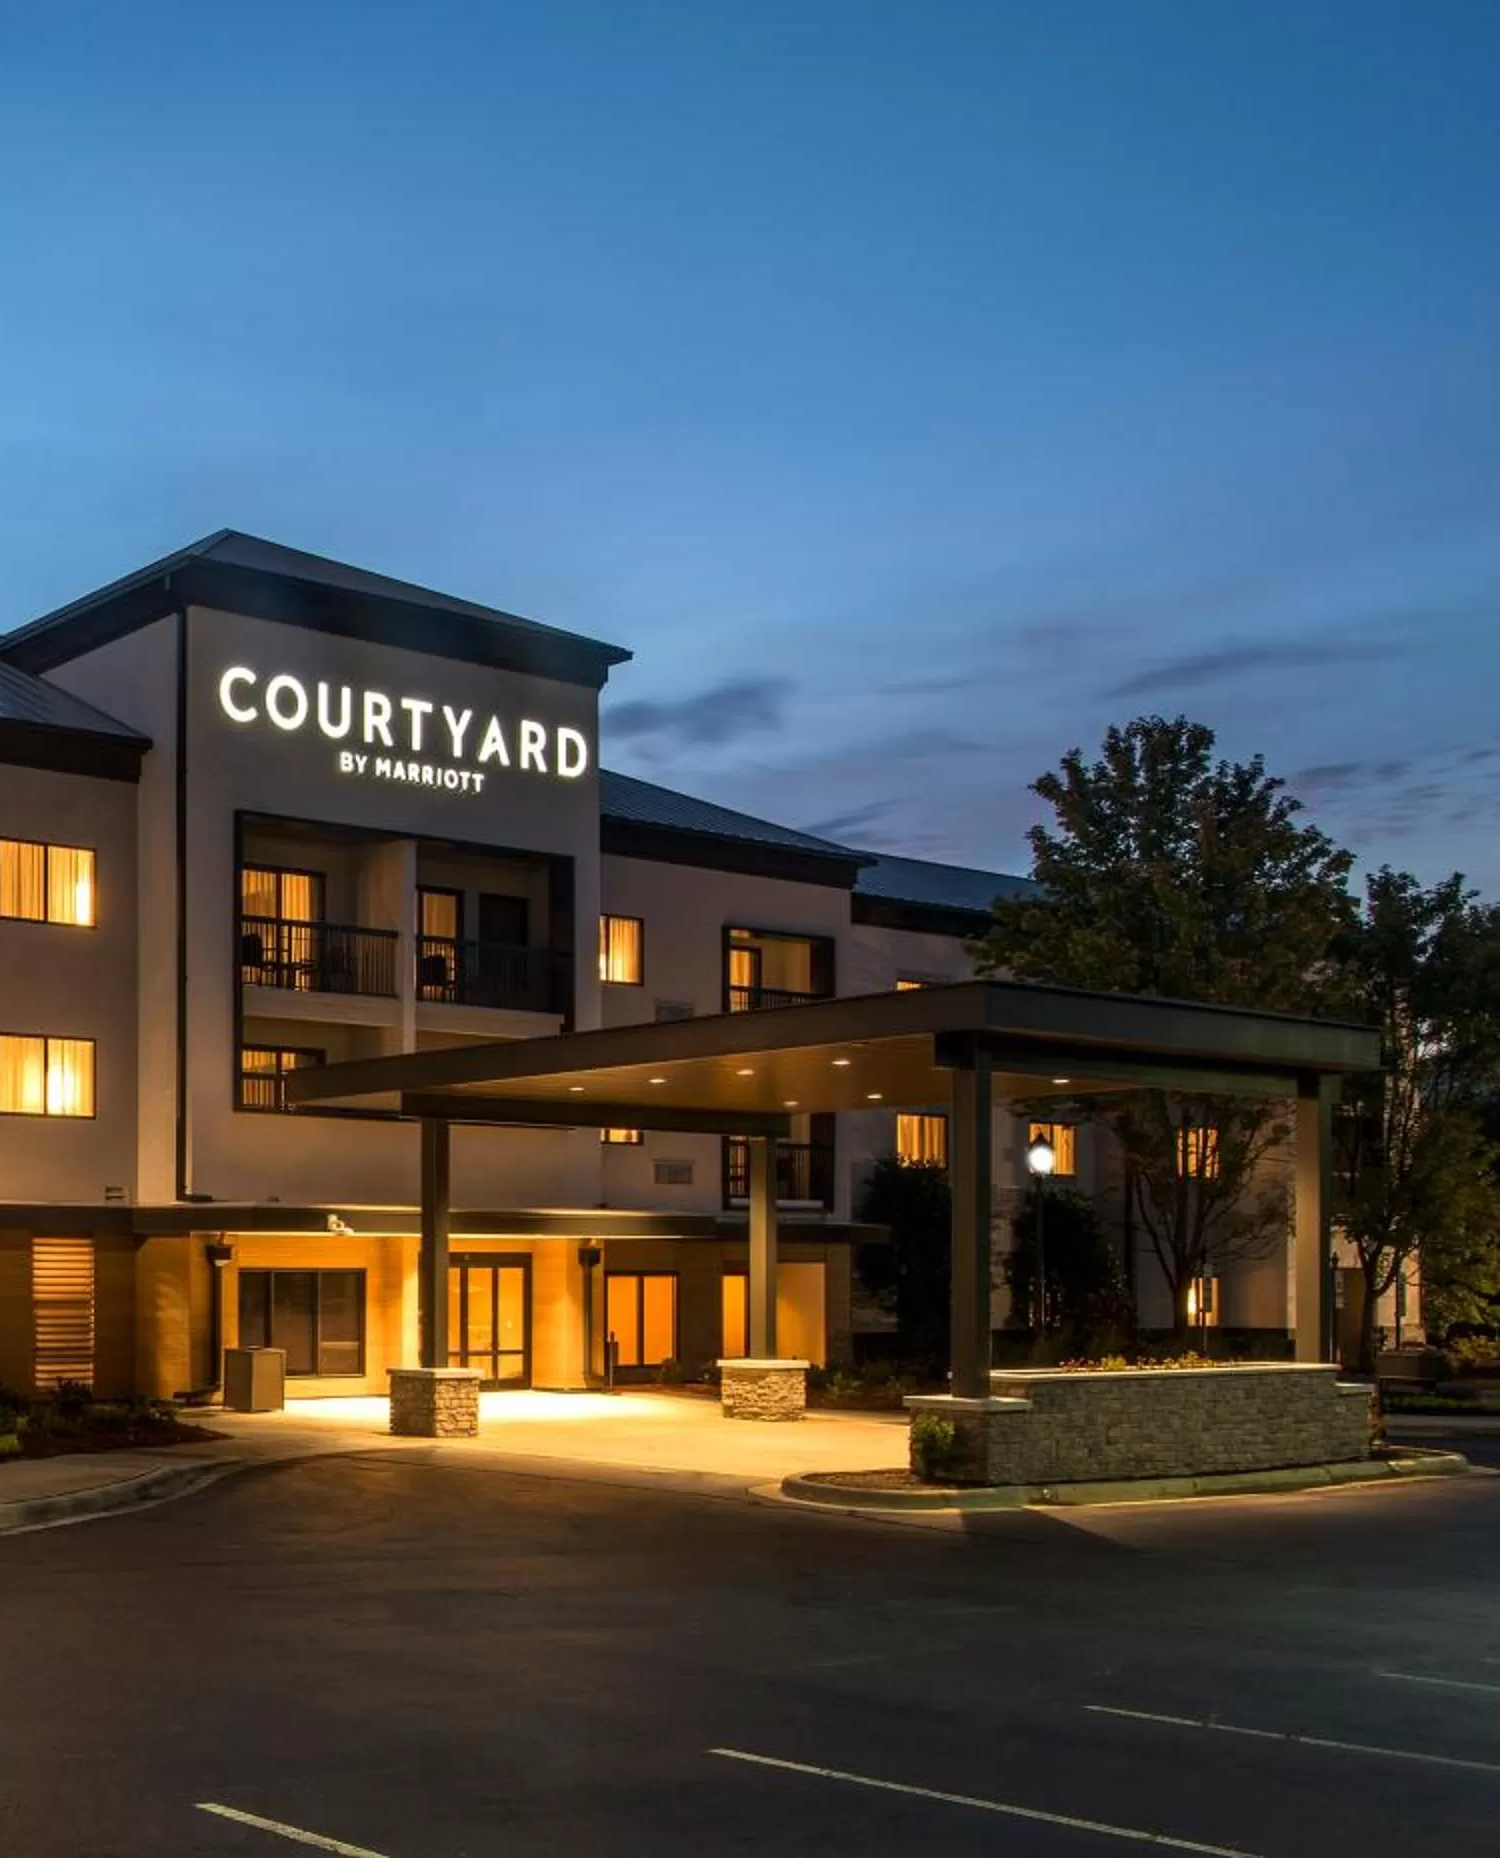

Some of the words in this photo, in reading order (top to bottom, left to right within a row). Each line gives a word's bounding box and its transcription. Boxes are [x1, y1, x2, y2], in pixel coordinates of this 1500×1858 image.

[218, 666, 589, 778] COURTYARD
[339, 751, 368, 774] BY
[375, 756, 485, 793] MARRIOTT
